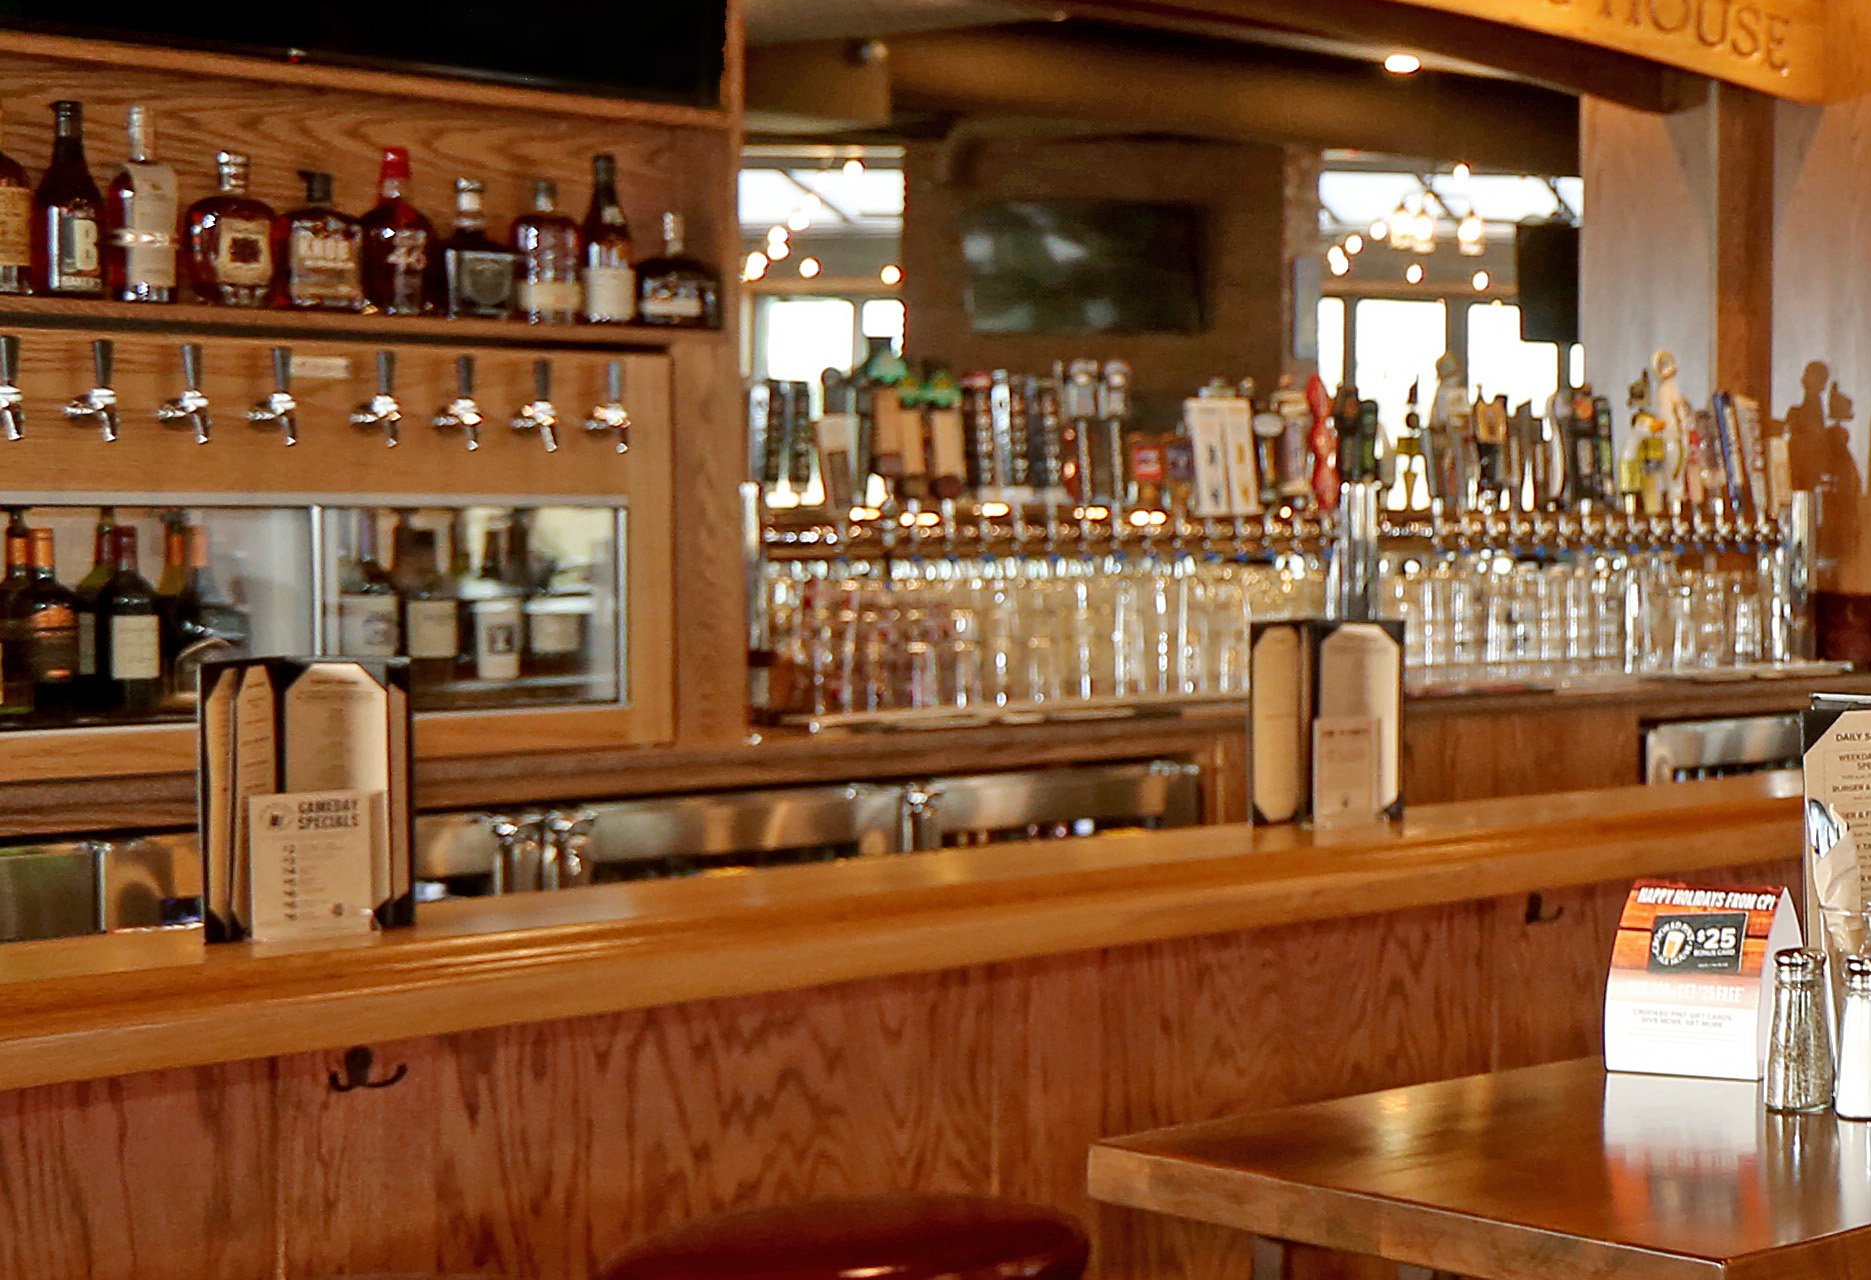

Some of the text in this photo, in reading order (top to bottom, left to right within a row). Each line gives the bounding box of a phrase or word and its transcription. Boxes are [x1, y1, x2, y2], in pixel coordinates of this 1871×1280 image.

[1836, 732, 1862, 743] DAILY
[1637, 886, 1675, 904] HAPPY
[1672, 889, 1727, 908] HOLIDAYS
[1725, 891, 1758, 910] FROM
[1696, 927, 1737, 950] $25
